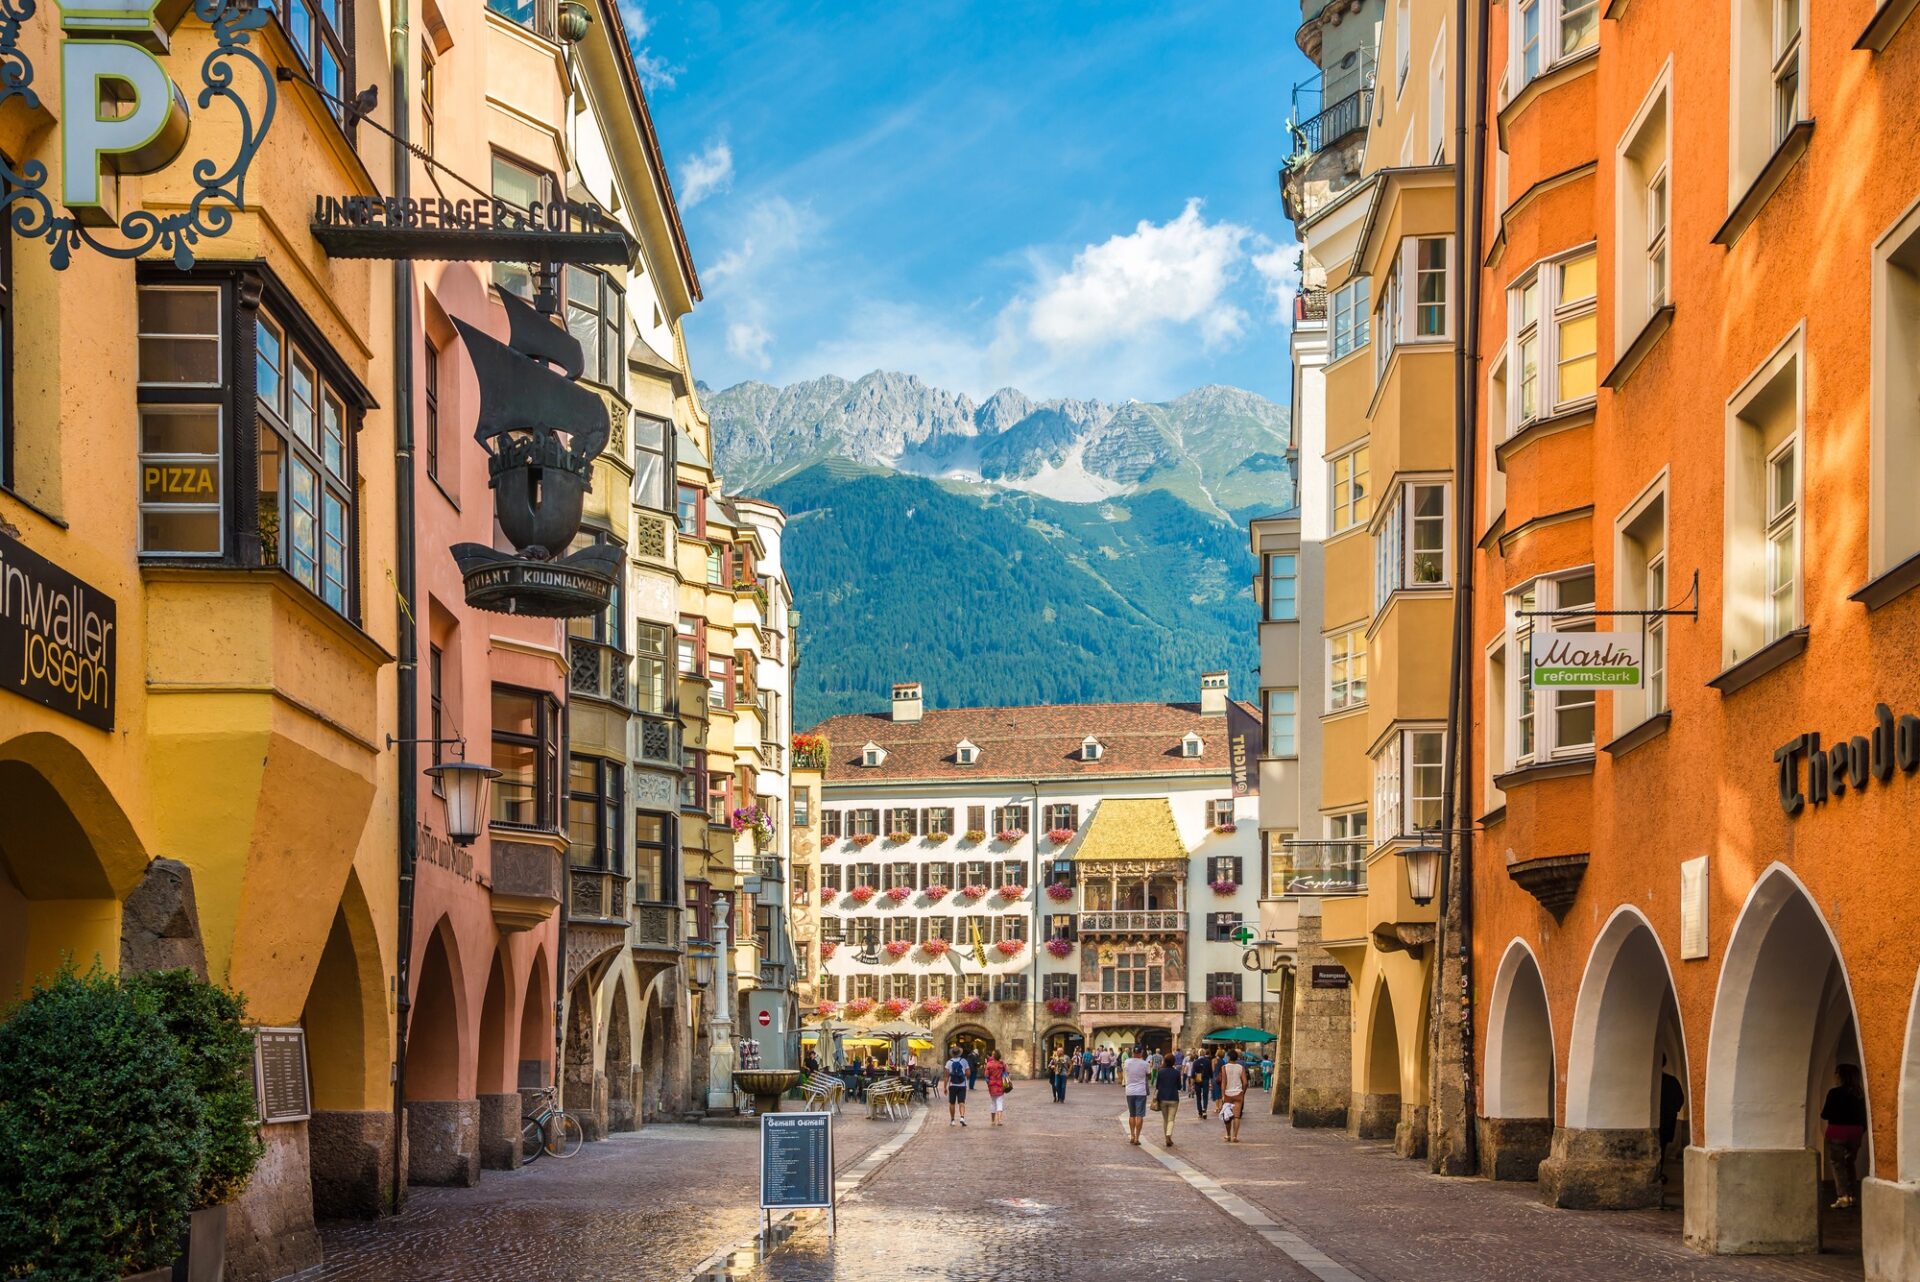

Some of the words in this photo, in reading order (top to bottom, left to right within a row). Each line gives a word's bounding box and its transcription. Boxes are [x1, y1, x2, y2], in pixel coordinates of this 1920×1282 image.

[314, 194, 507, 231] UNTERBERGER
[145, 467, 214, 493] PIZZA
[523, 570, 608, 596] KOLONIALWAREN
[20, 613, 109, 711] joseph
[1534, 639, 1640, 667] Martin
[1543, 671, 1630, 682] reformstark
[1773, 702, 1920, 814] Theodo
